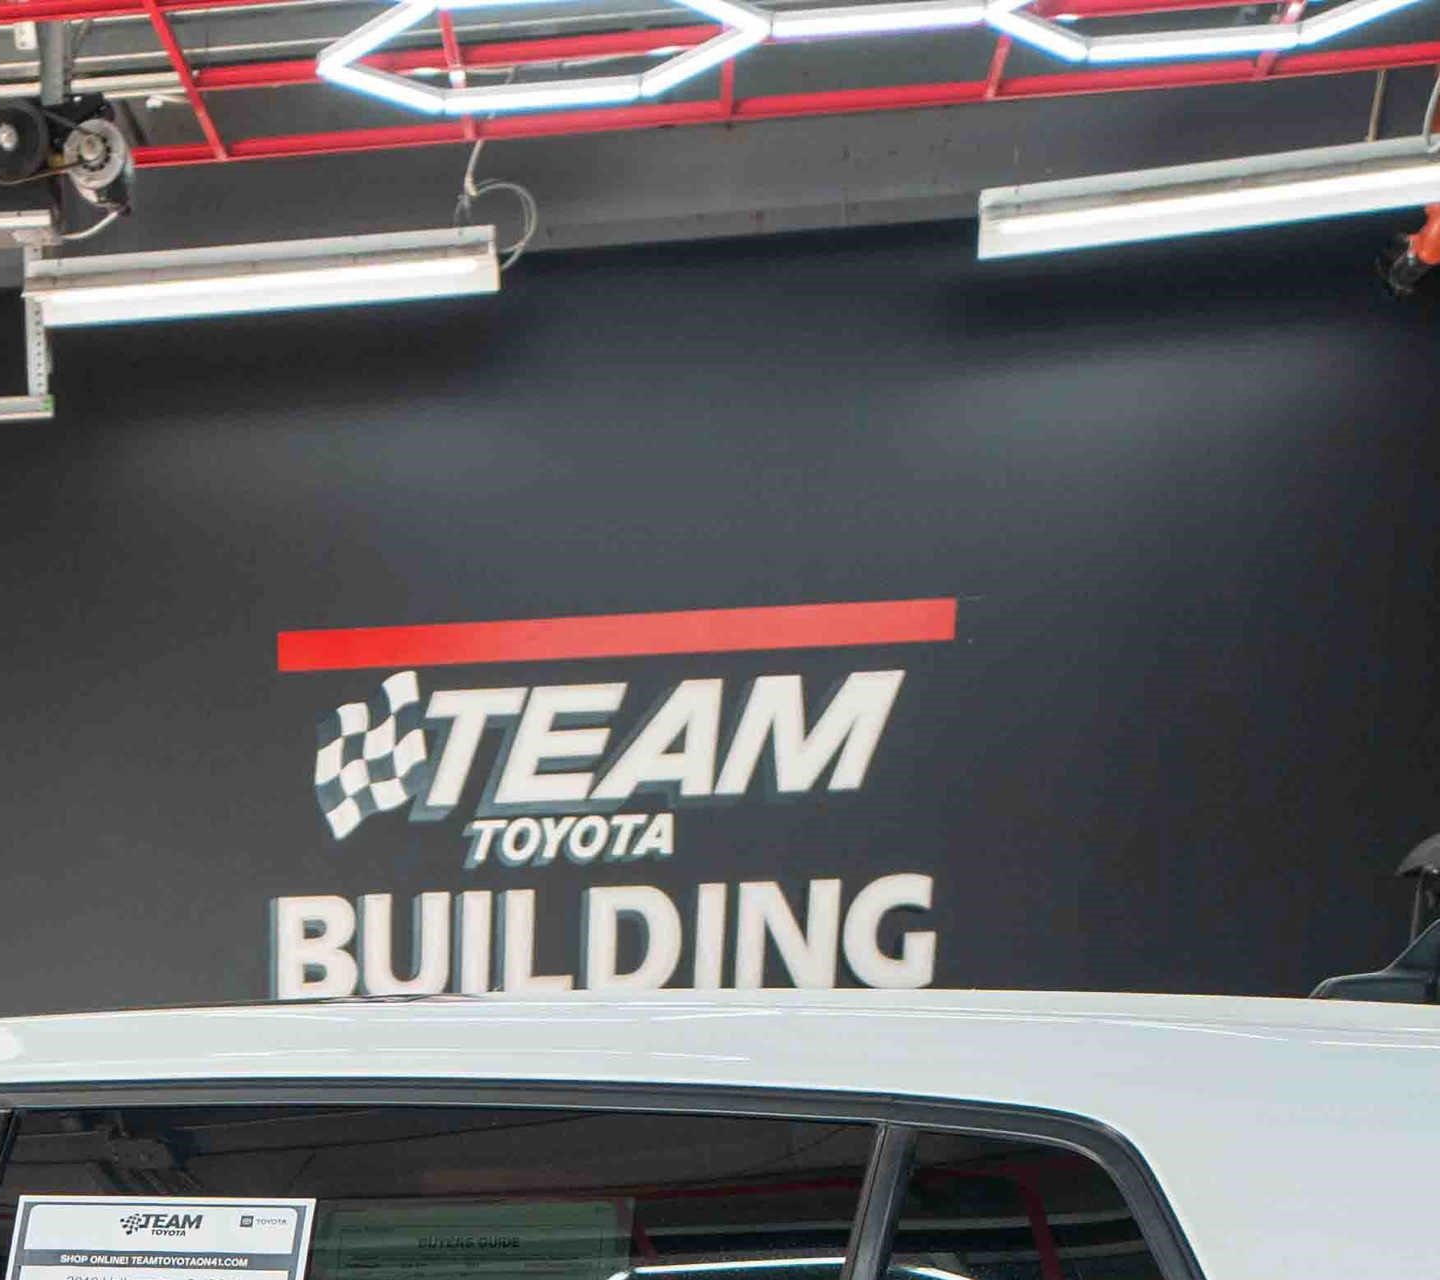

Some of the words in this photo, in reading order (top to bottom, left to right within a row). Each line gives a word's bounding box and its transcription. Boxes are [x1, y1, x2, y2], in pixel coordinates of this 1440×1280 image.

[418, 669, 906, 810] TEAM
[469, 812, 675, 863] TOYOTA
[272, 873, 936, 1000] BUILDING
[140, 1213, 204, 1230] TEAM
[151, 1229, 186, 1237] TOYOTA
[478, 1235, 521, 1250] GUIDE
[60, 1254, 89, 1264] SHOP
[90, 1255, 129, 1265] ONLINE!
[131, 1256, 249, 1268] TEAMTOYOTAON41.COM
